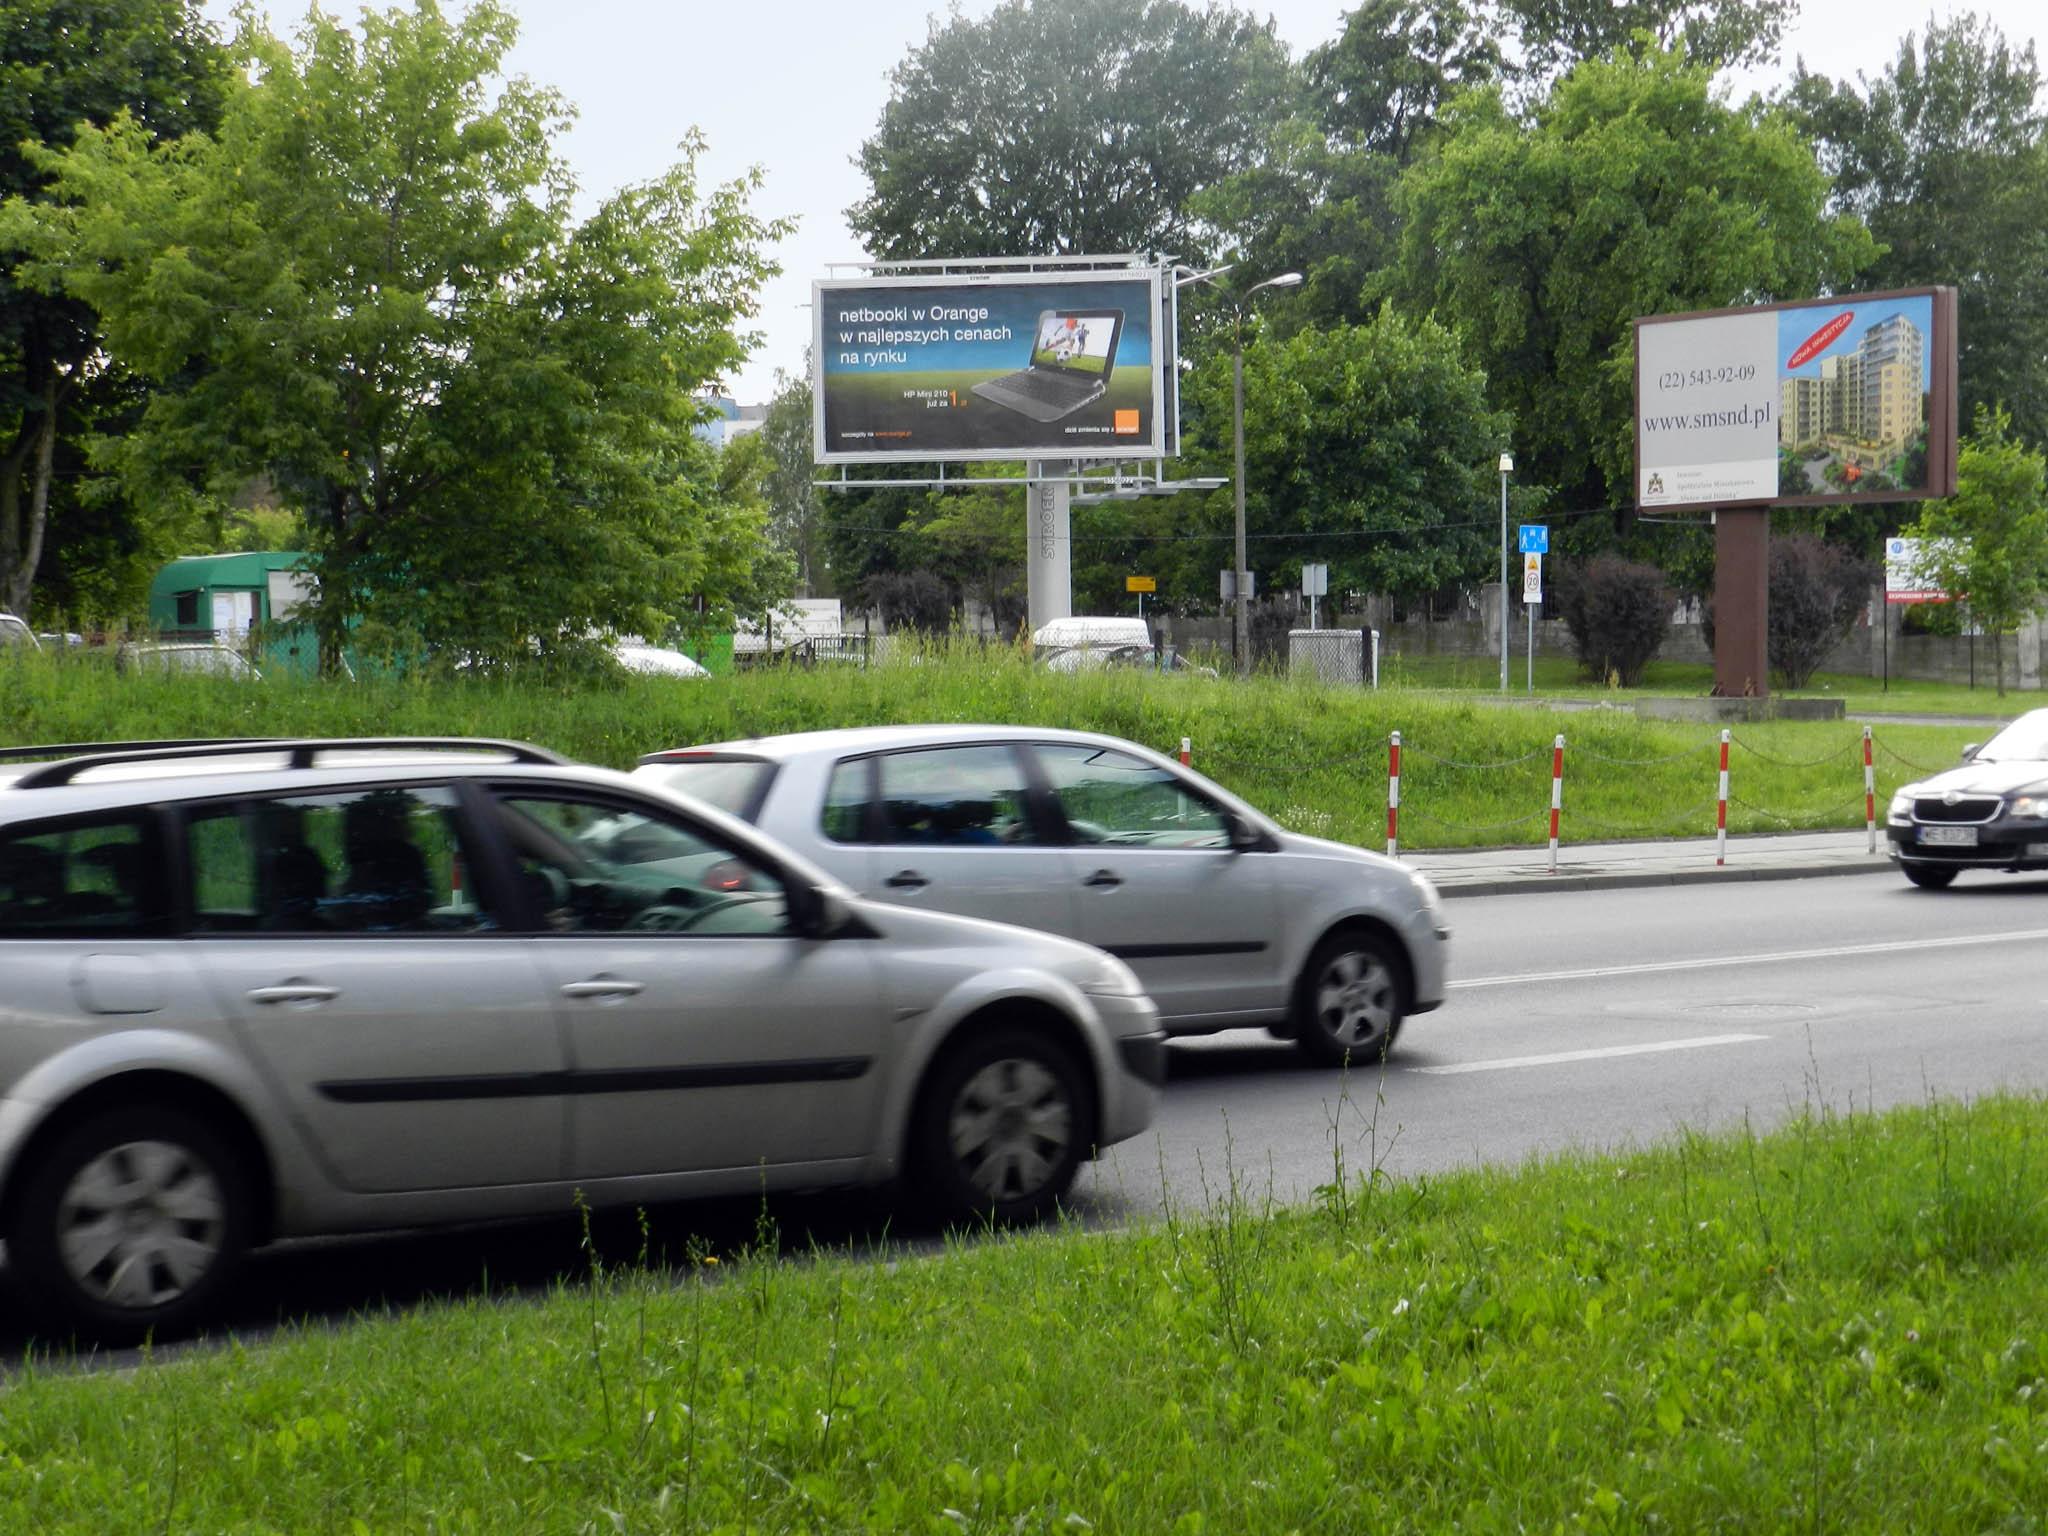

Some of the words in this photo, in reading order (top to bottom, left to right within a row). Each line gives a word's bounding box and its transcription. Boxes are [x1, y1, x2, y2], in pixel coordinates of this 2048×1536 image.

[840, 306, 907, 323] netbooki
[912, 310, 926, 321] w
[930, 305, 989, 323] Orange
[840, 331, 853, 343] w
[857, 327, 949, 346] najlepszych
[954, 325, 1012, 341] cenach
[840, 352, 859, 364] na
[864, 349, 907, 367] rynku
[1659, 371, 1685, 391] (22)
[1689, 364, 1755, 386] 543-92-09
[903, 390, 916, 398] HP
[917, 390, 932, 398] Mini
[933, 389, 948, 398] 210
[1644, 401, 1771, 432] www.smsnd.pl
